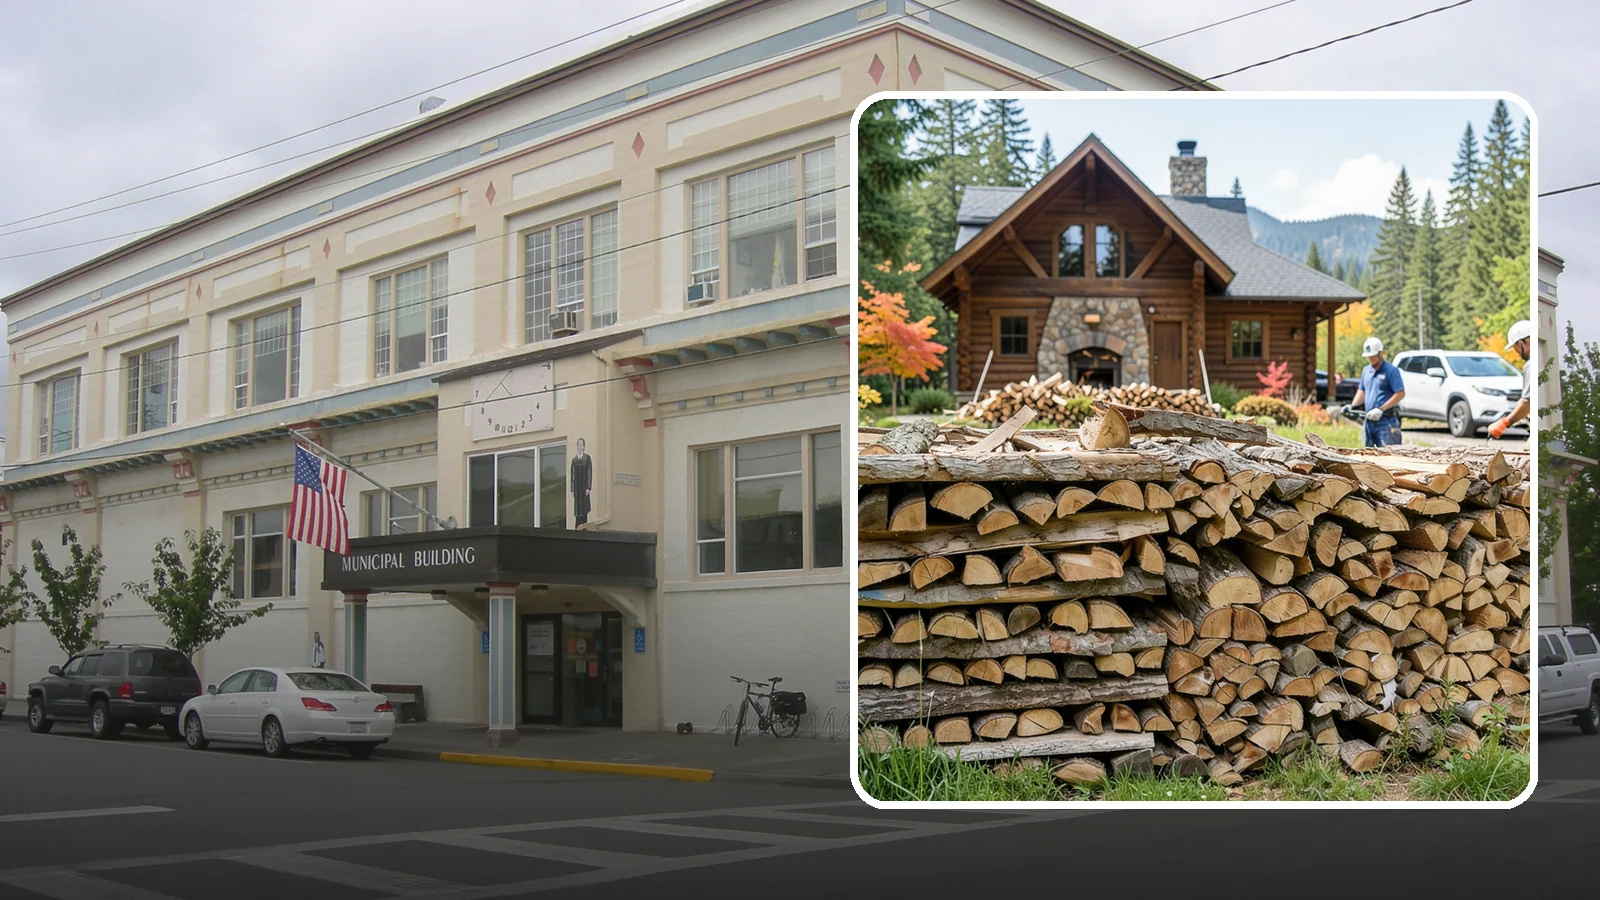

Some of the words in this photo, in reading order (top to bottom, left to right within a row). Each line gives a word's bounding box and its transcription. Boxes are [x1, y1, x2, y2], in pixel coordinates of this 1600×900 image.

[546, 361, 552, 370] 6
[481, 407, 485, 415] 8
[488, 417, 492, 426] 9
[529, 414, 533, 422] 3
[495, 424, 500, 432] 10
[521, 420, 525, 428] 2
[507, 425, 513, 433] 12
[342, 552, 405, 571] MUNICIPAL
[414, 546, 475, 567] BUILDING
